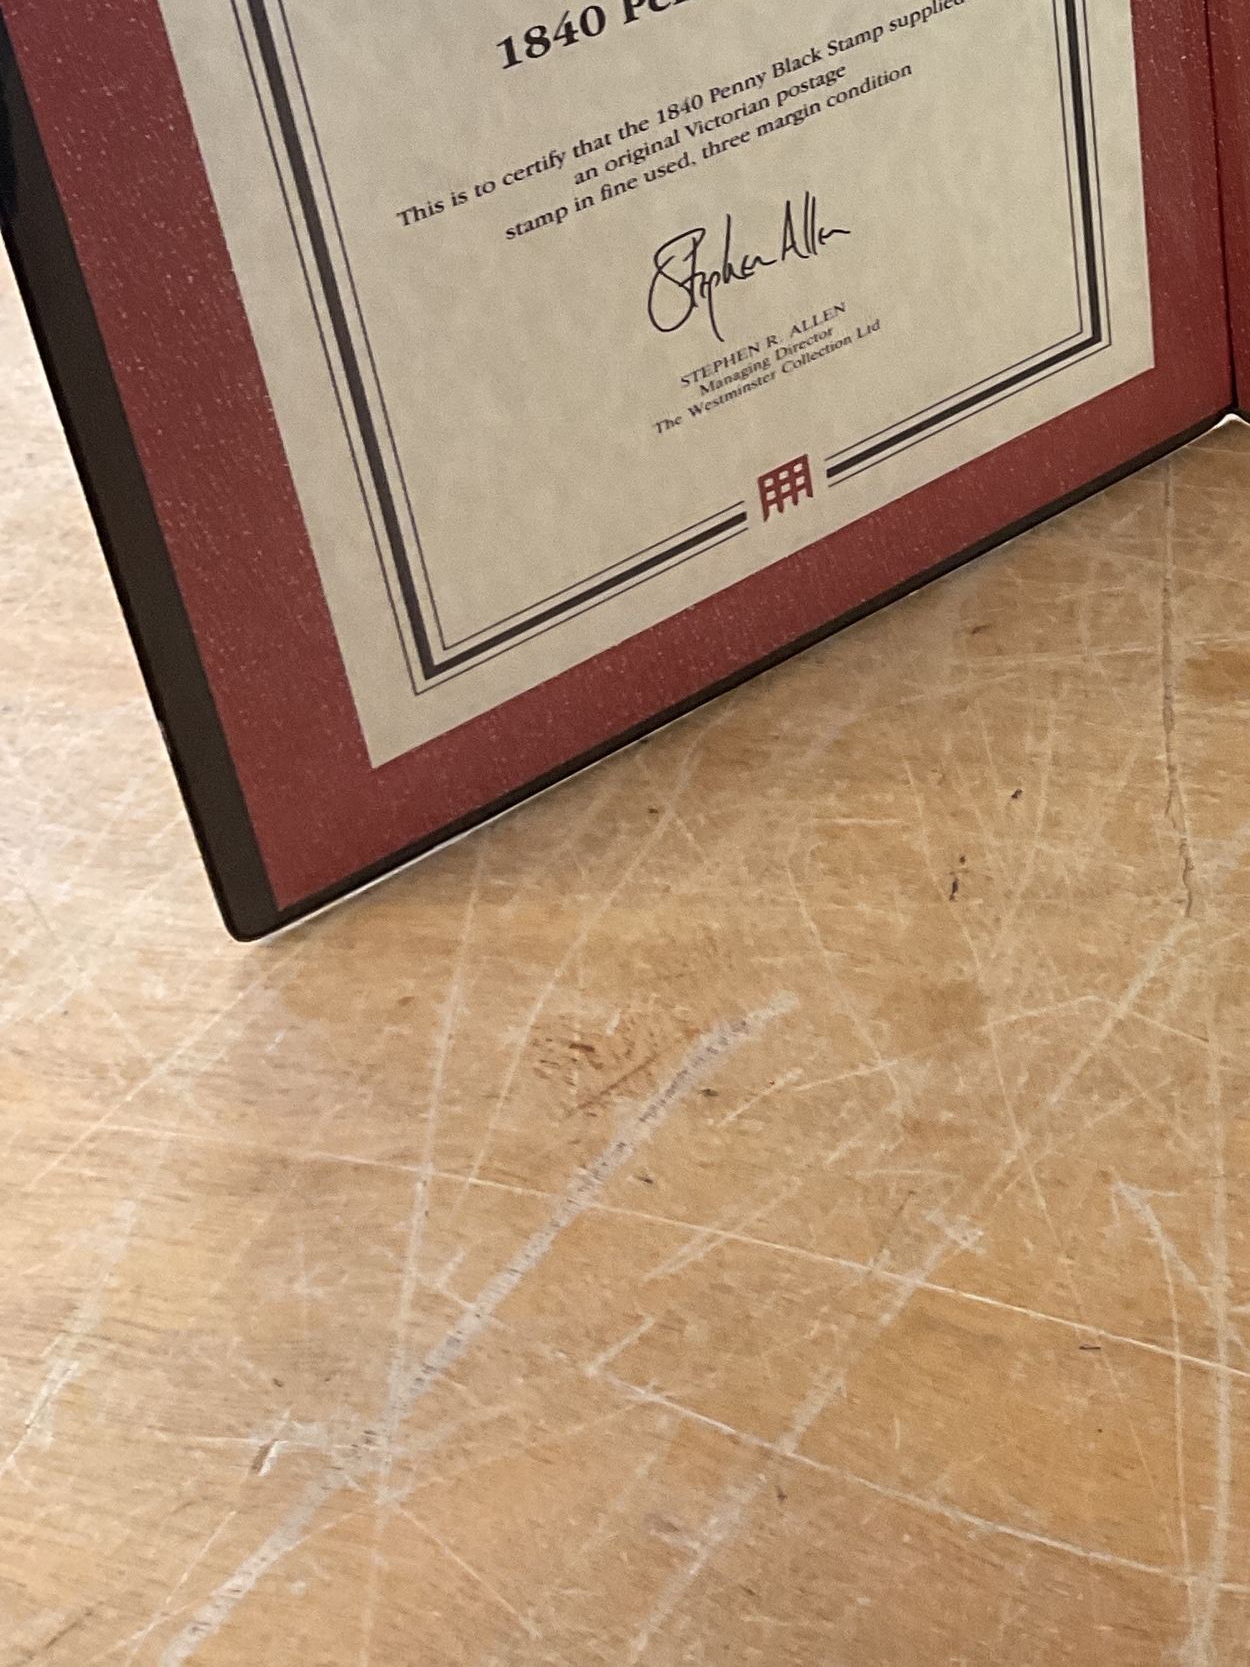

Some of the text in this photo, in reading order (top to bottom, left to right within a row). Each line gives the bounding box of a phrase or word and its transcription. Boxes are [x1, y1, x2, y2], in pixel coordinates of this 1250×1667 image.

[495, 4, 606, 70] 1840
[395, 200, 445, 226] This
[450, 190, 468, 207] is
[473, 180, 496, 198] to
[501, 149, 566, 186] certify
[572, 132, 612, 158] that
[617, 118, 650, 140] the
[656, 93, 704, 125] 1840
[709, 71, 767, 104] Penny
[771, 46, 823, 79] Black
[826, 25, 884, 56] Stamp
[505, 64, 912, 240] stamp in fine used, three margin condition
[573, 65, 846, 185] an original Victorian postage
[652, 318, 881, 434] The Westminster Collection Ltd
[680, 341, 760, 387] STEPHEN
[789, 301, 846, 338] ALLEN
[698, 327, 833, 396] Managing Director
